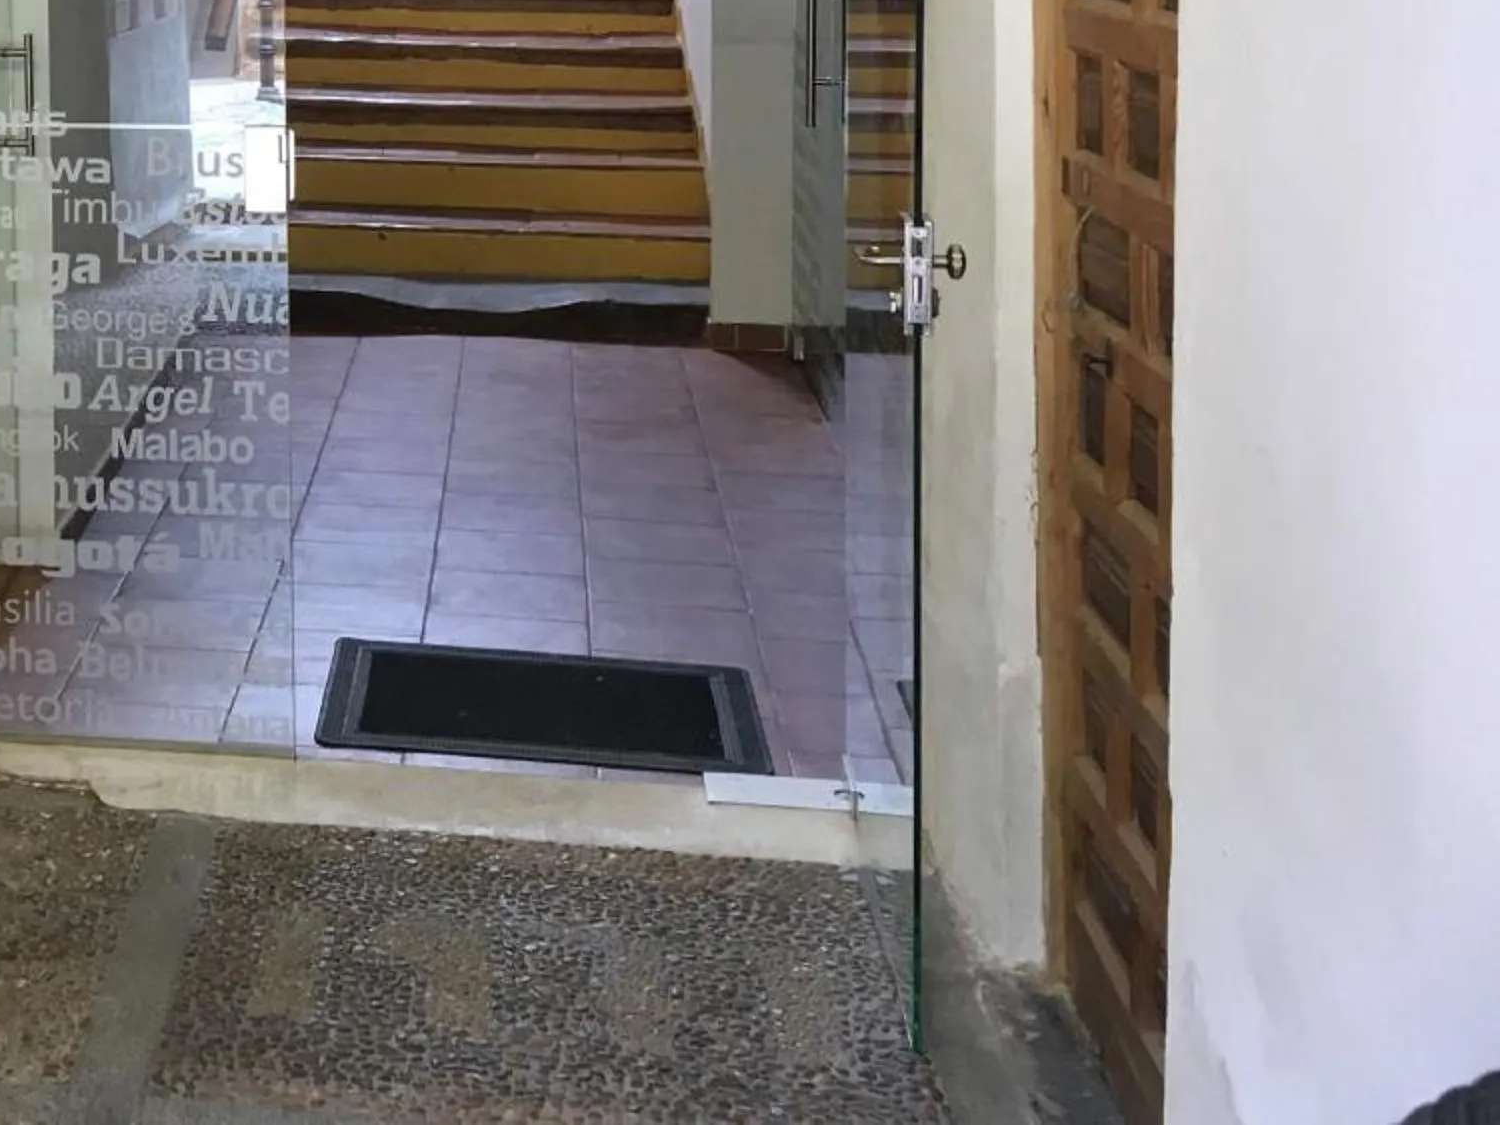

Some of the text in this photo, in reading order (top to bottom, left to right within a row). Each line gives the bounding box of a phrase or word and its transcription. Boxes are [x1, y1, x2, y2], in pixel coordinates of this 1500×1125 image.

[88, 373, 214, 422] Argel
[233, 380, 290, 425] Te
[111, 427, 254, 464] Malabo
